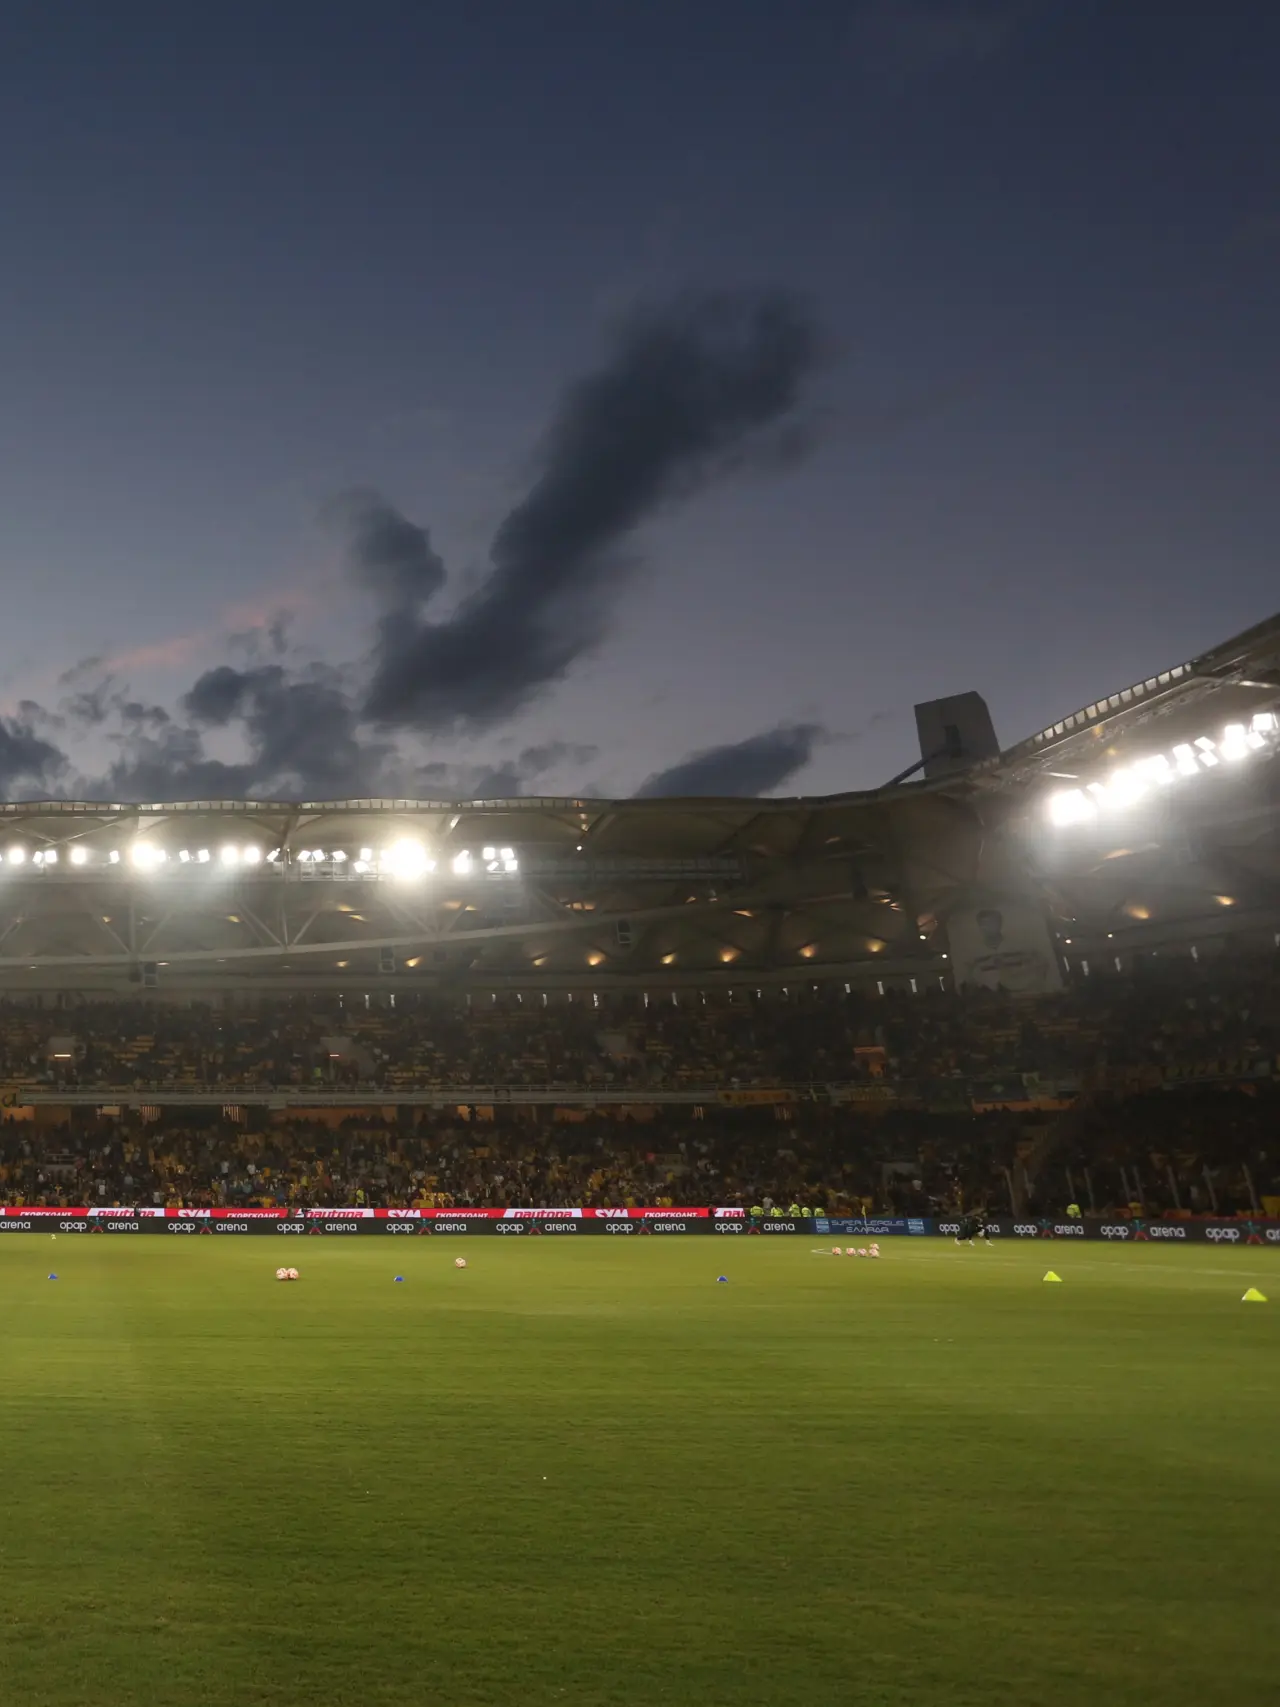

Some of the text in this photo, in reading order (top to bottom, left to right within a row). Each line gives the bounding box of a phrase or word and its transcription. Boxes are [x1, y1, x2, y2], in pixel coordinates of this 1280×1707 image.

[0, 1221, 31, 1230] arena
[59, 1221, 139, 1233] opap arena
[167, 1222, 248, 1234] opap arena
[276, 1223, 358, 1234] opap arena
[386, 1223, 467, 1234] opap arena
[495, 1223, 577, 1234] opap arena
[605, 1223, 686, 1234] opap arena
[714, 1222, 796, 1234] opap arena
[938, 1223, 961, 1235] opap
[1013, 1224, 1038, 1236] opap
[1054, 1224, 1085, 1235] arena
[1100, 1225, 1186, 1239] opap arena
[1205, 1227, 1240, 1242] opap
